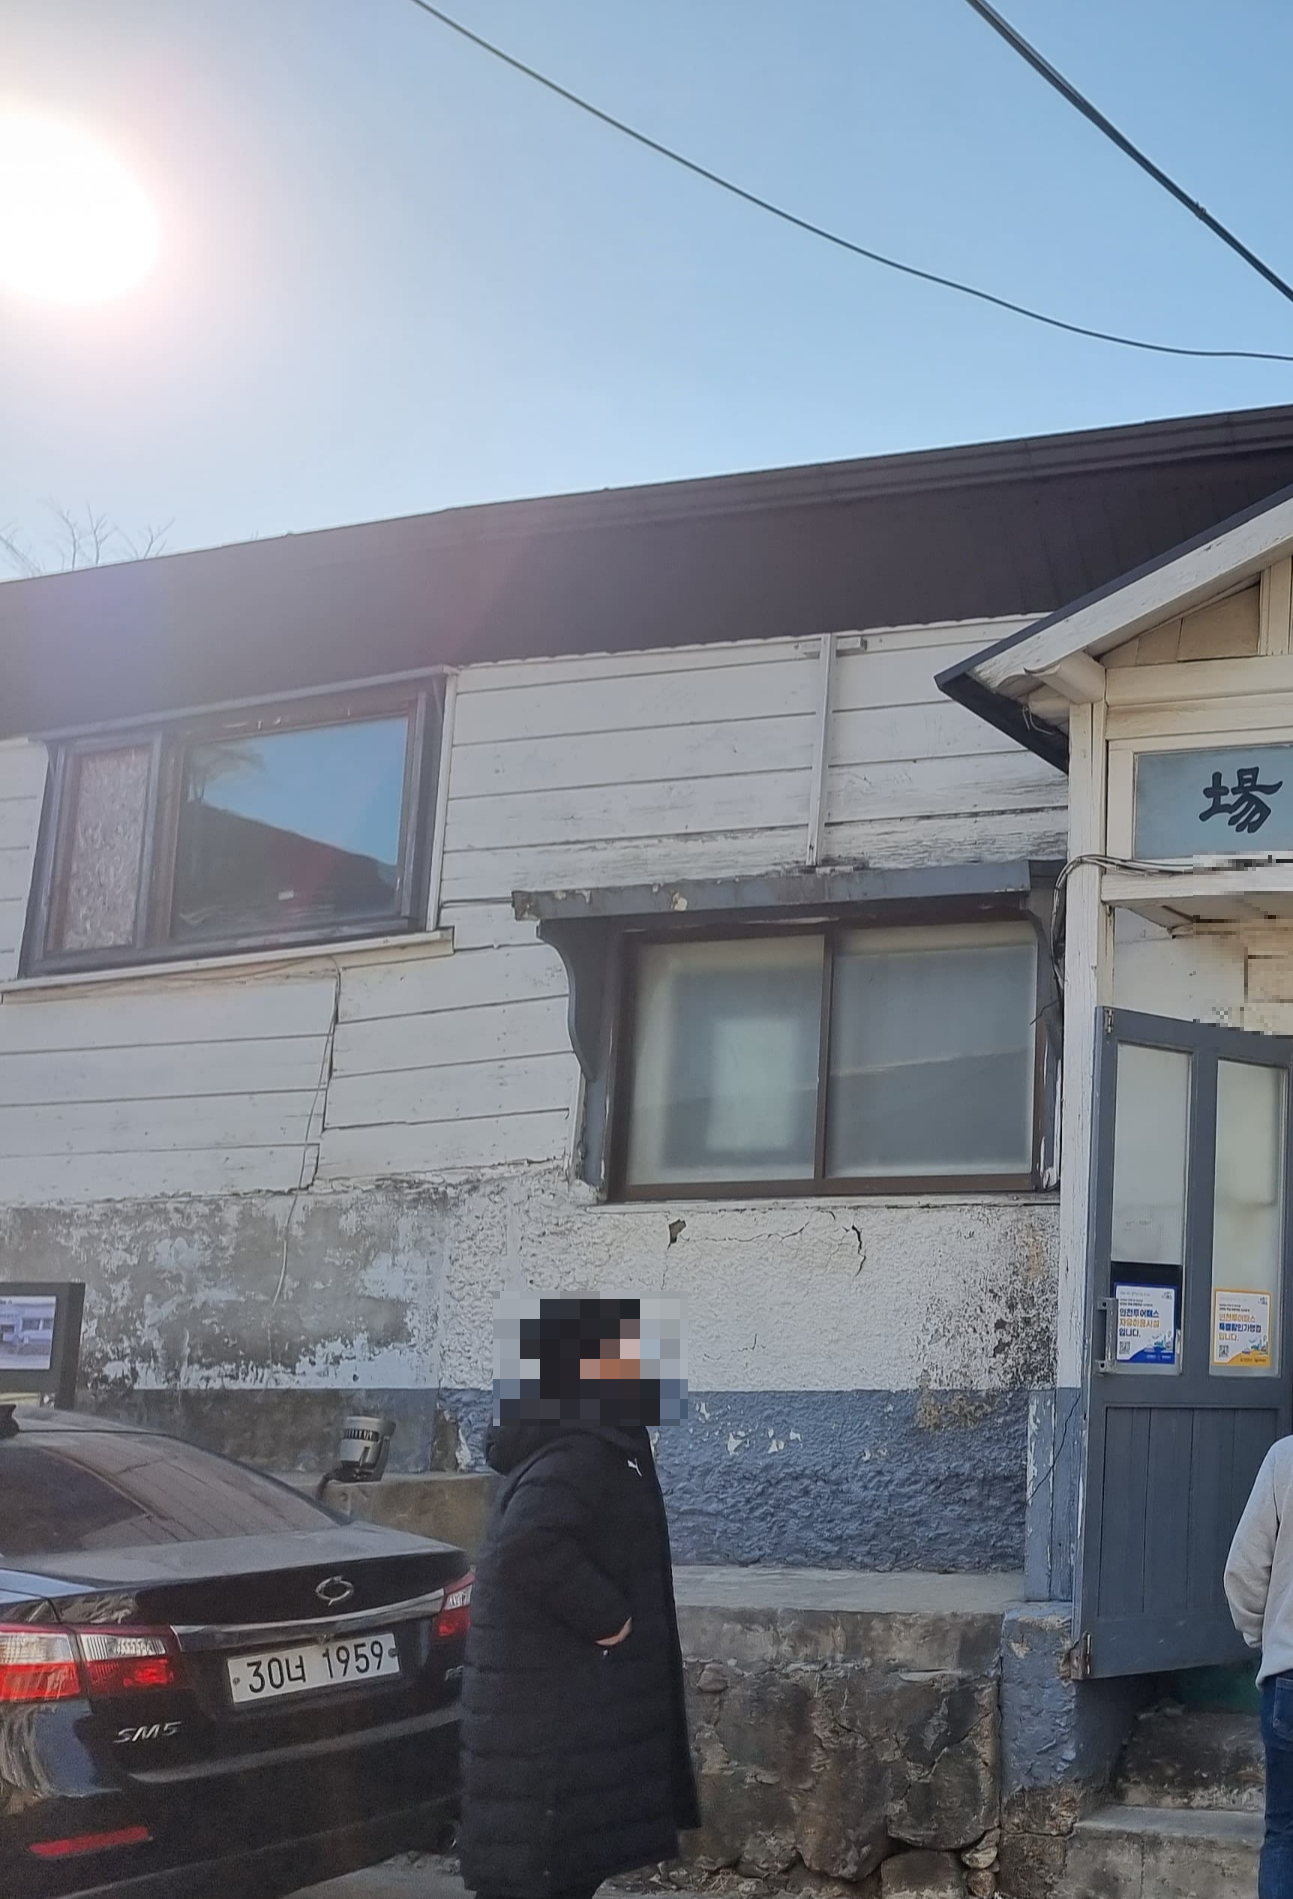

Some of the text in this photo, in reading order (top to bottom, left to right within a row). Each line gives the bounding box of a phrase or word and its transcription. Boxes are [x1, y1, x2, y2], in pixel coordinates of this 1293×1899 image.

[1119, 1328, 1141, 1338] 입니다.
[322, 1640, 384, 1681] 1959
[113, 1721, 182, 1745] SM5
